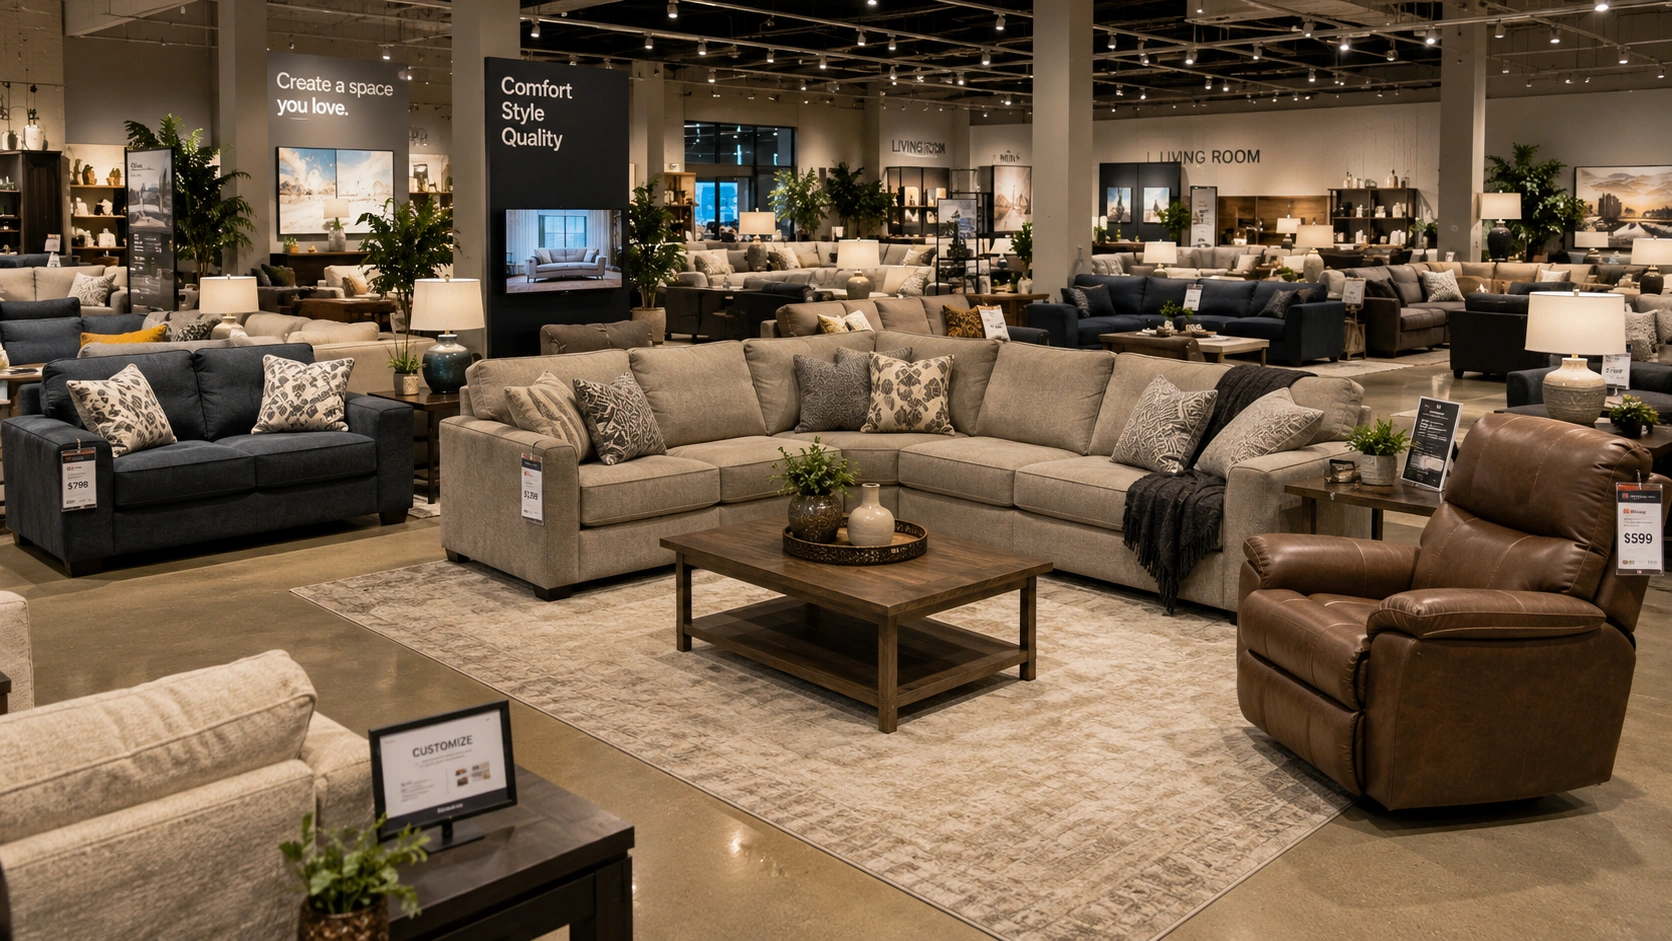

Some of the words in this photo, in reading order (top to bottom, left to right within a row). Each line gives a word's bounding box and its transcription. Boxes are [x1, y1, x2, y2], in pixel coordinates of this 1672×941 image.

[276, 72, 331, 92] Create
[335, 82, 345, 93] a
[349, 81, 393, 98] space
[501, 76, 573, 99] Comfort
[276, 98, 308, 116] you
[311, 97, 349, 116] love.
[501, 101, 545, 125] Style
[501, 126, 563, 151] Quality
[1211, 149, 1260, 164] ROOM
[1624, 532, 1653, 544] $599
[412, 735, 473, 758] CUSTOMIZE
